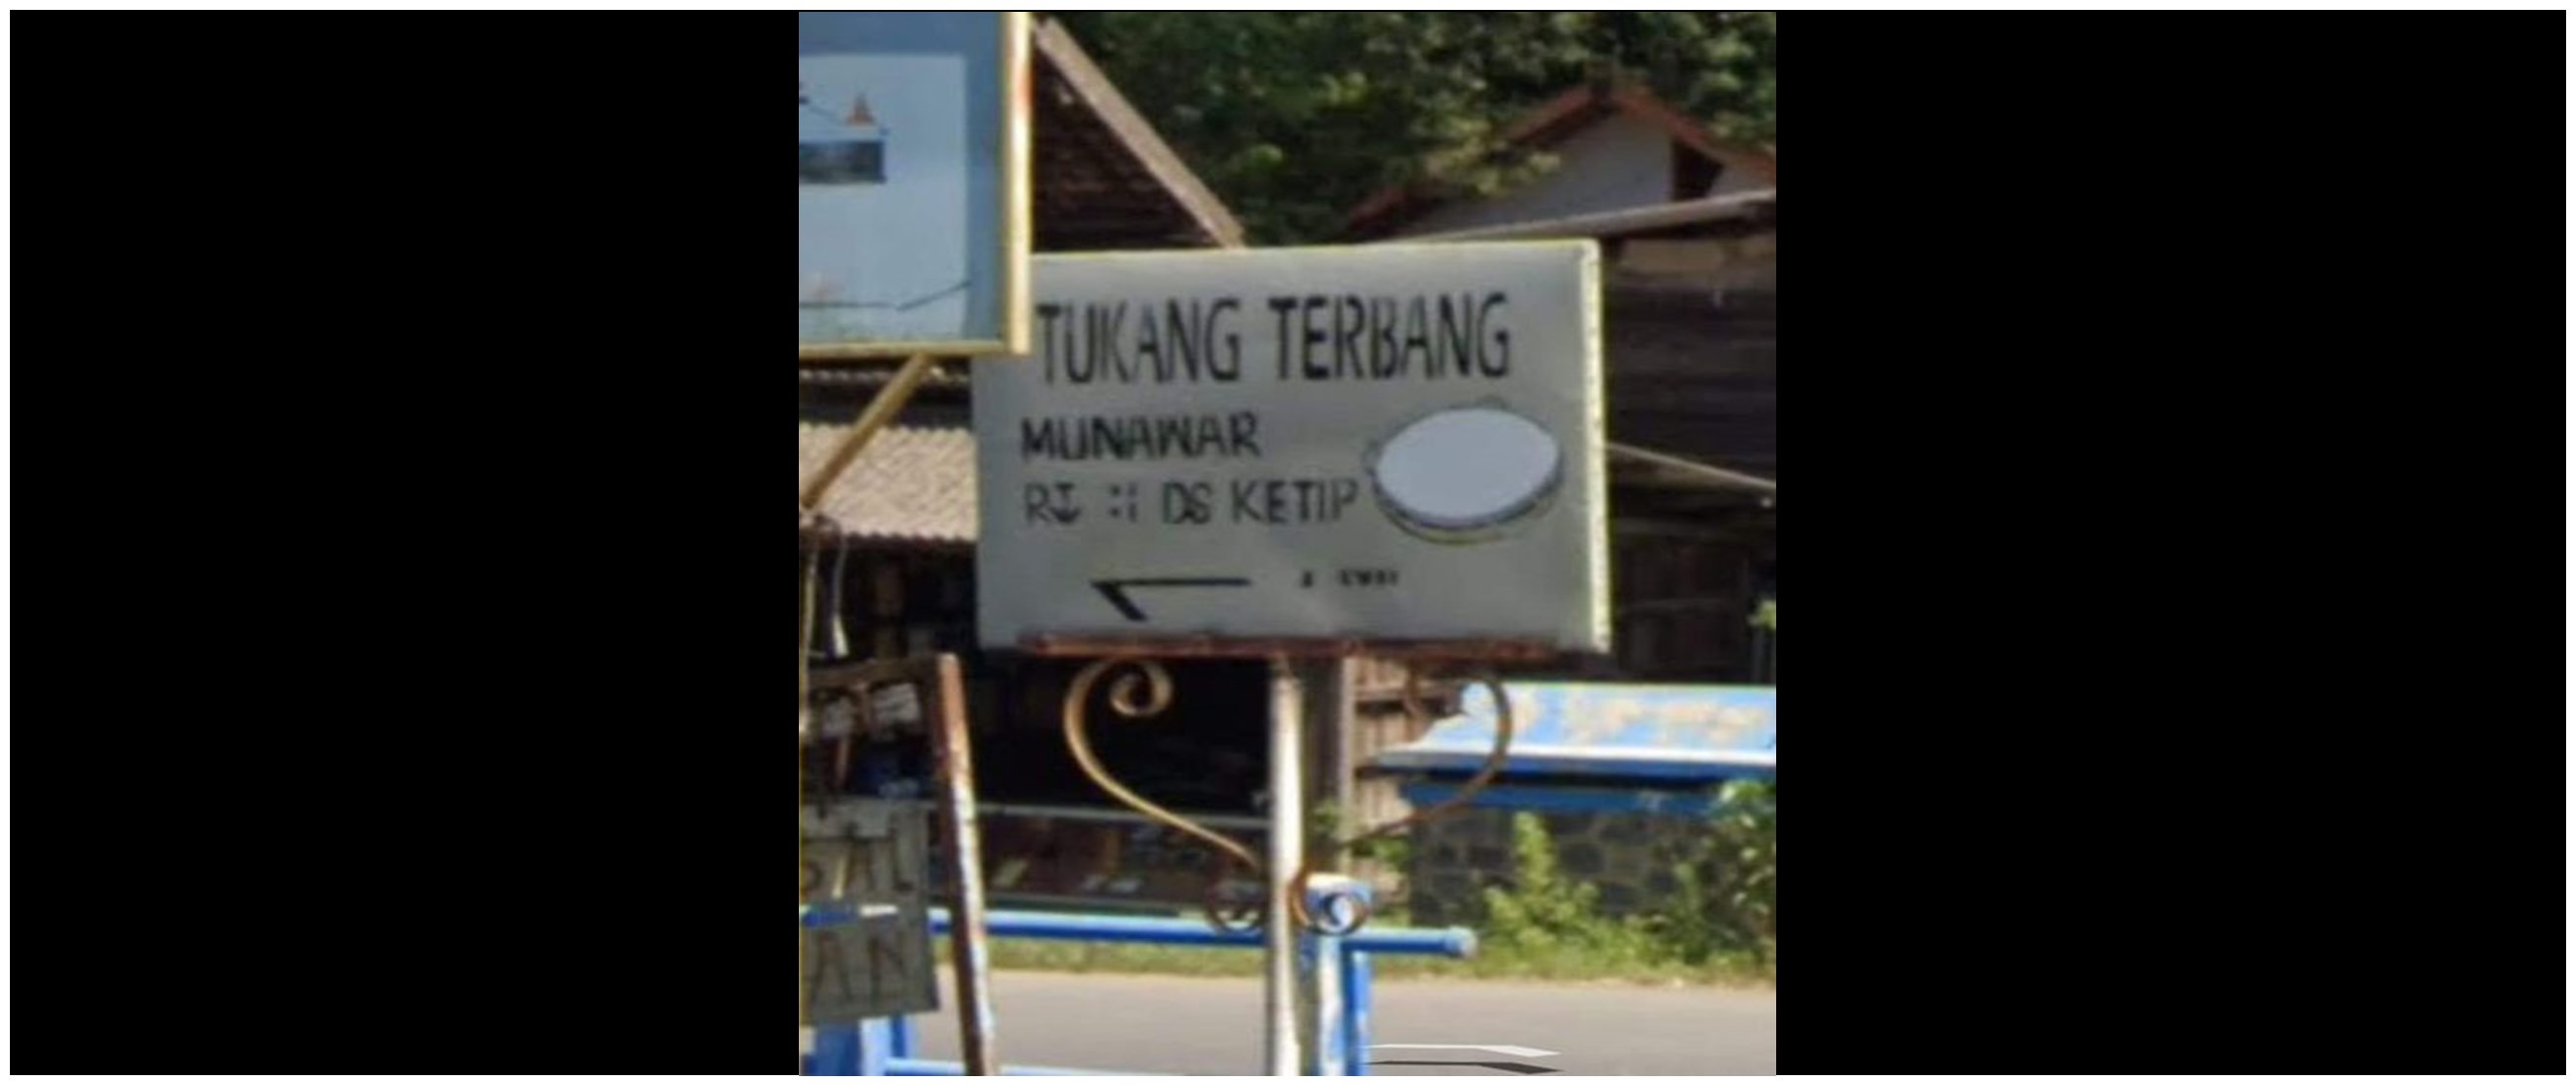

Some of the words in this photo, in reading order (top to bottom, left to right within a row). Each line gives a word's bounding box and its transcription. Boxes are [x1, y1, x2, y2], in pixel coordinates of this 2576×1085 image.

[1037, 298, 1240, 385] TUKANG
[1268, 293, 1510, 380] TERBANG
[1021, 410, 1261, 462] MUNAWAR
[1232, 478, 1358, 524] KETIP
